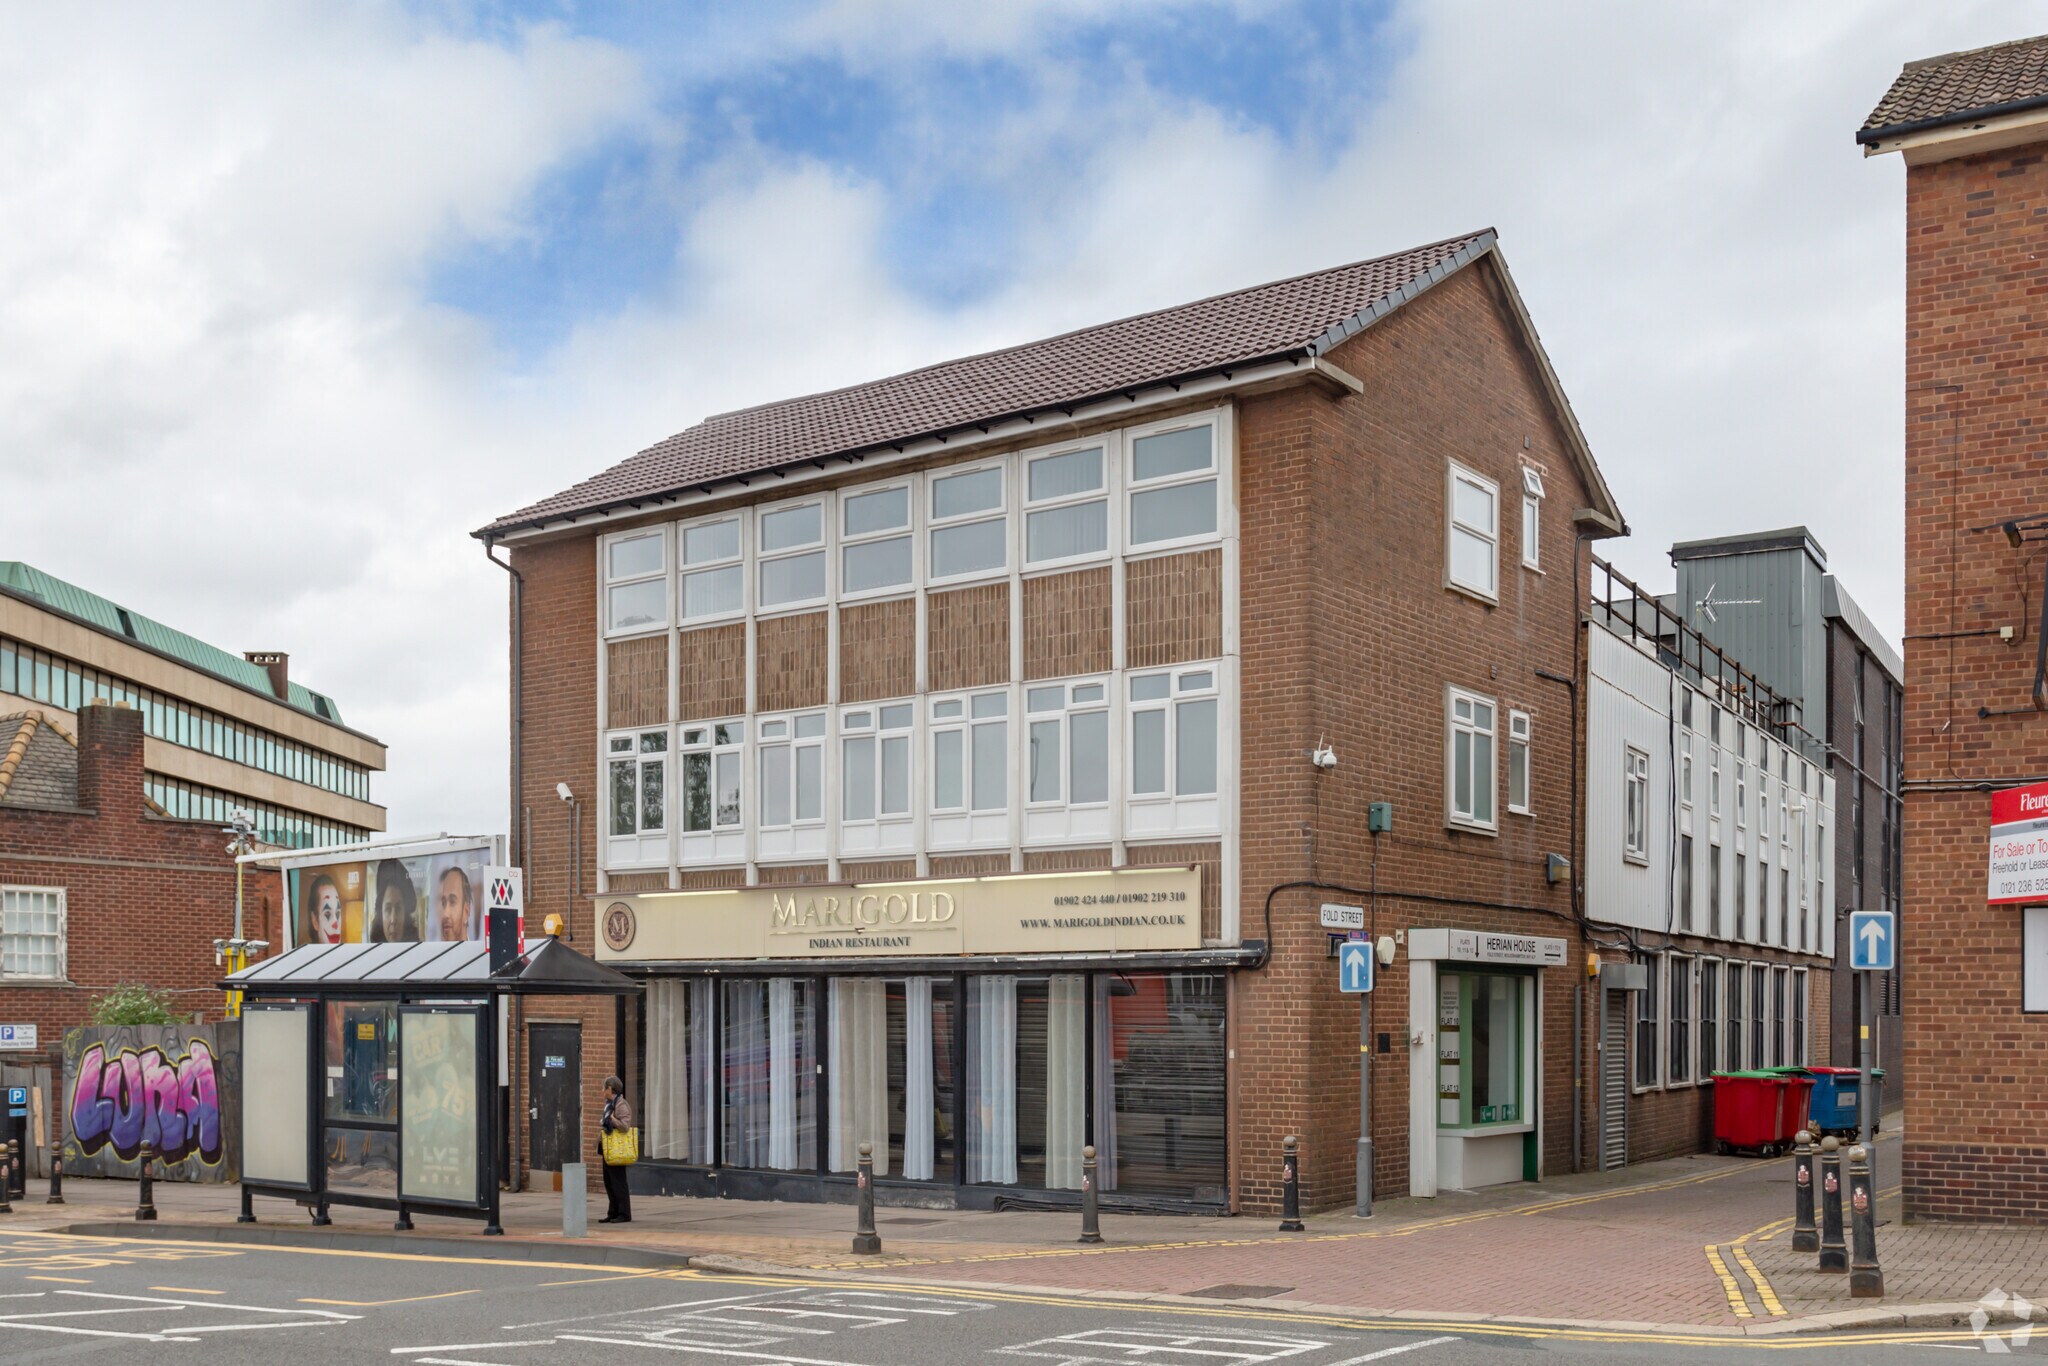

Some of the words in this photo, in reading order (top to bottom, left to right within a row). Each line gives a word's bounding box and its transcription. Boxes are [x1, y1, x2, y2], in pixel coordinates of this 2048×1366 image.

[1993, 845, 2005, 859] For
[2006, 842, 2024, 858] Sale
[2026, 842, 2036, 855] or
[1992, 860, 2018, 875] Freehold
[2020, 861, 2027, 871] or
[2000, 881, 2016, 894] 0121
[2018, 879, 2032, 893] 236
[1053, 895, 1079, 906] 01902
[1081, 895, 1097, 905] 424
[1098, 894, 1115, 905] 440
[1122, 892, 1148, 904] 01902
[1151, 892, 1167, 903] 219
[1169, 891, 1186, 902] 310
[771, 891, 956, 928] MARIGOLD
[1323, 909, 1338, 922] FOLD
[1341, 911, 1362, 924] STREET
[611, 915, 626, 936] M
[1020, 918, 1051, 929] WWW.
[1053, 915, 1185, 929] MARIGOLDINDIAN.CO.UK
[809, 938, 843, 949] INDIAN
[845, 936, 911, 949] RESTAURANT
[1486, 938, 1512, 952] HERIAN
[1514, 939, 1536, 953] HOUSE
[1441, 1017, 1453, 1025] FLAT
[3, 1028, 12, 1039] P
[1441, 1050, 1453, 1058] FLAT
[1441, 1084, 1453, 1092] FLAT
[13, 1090, 22, 1102] P
